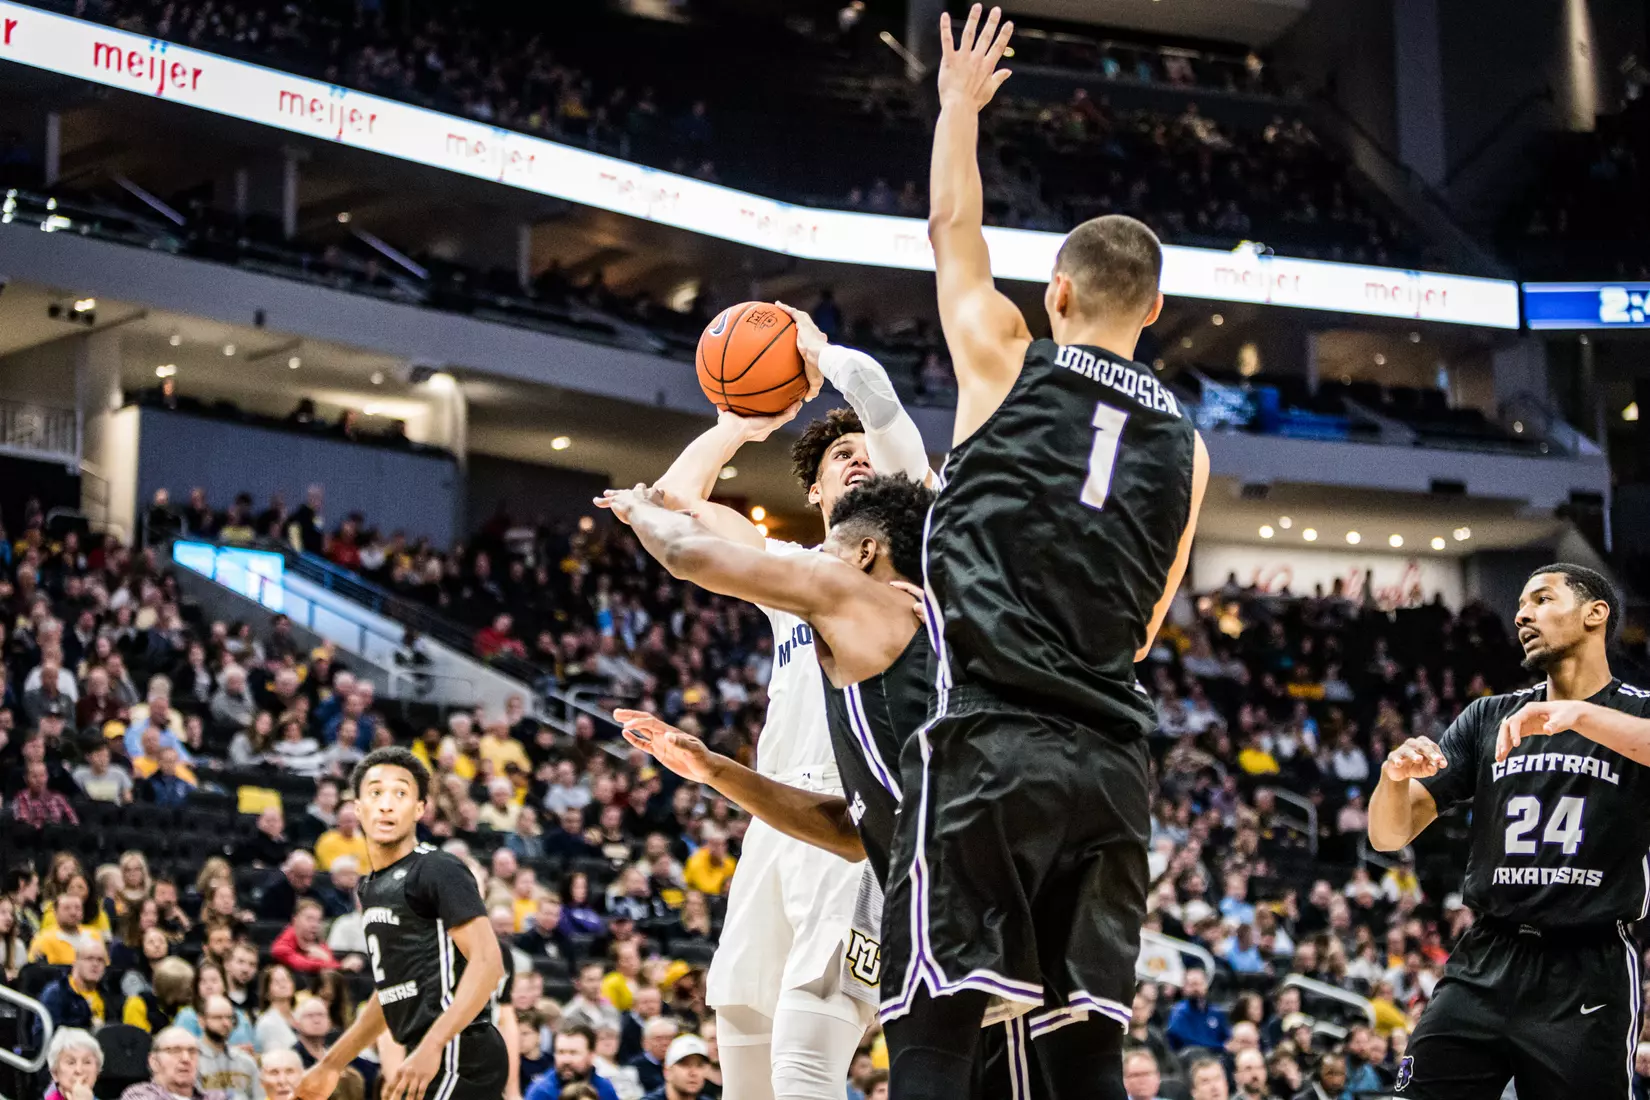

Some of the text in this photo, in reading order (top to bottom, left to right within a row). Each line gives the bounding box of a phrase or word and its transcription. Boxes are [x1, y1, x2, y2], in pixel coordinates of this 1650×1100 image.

[94, 39, 203, 96] meijer
[279, 84, 377, 142] meijer
[1080, 401, 1131, 511] 1
[1491, 752, 1620, 786] CENTRAL
[1504, 793, 1587, 857] 24
[846, 928, 881, 987] MU
